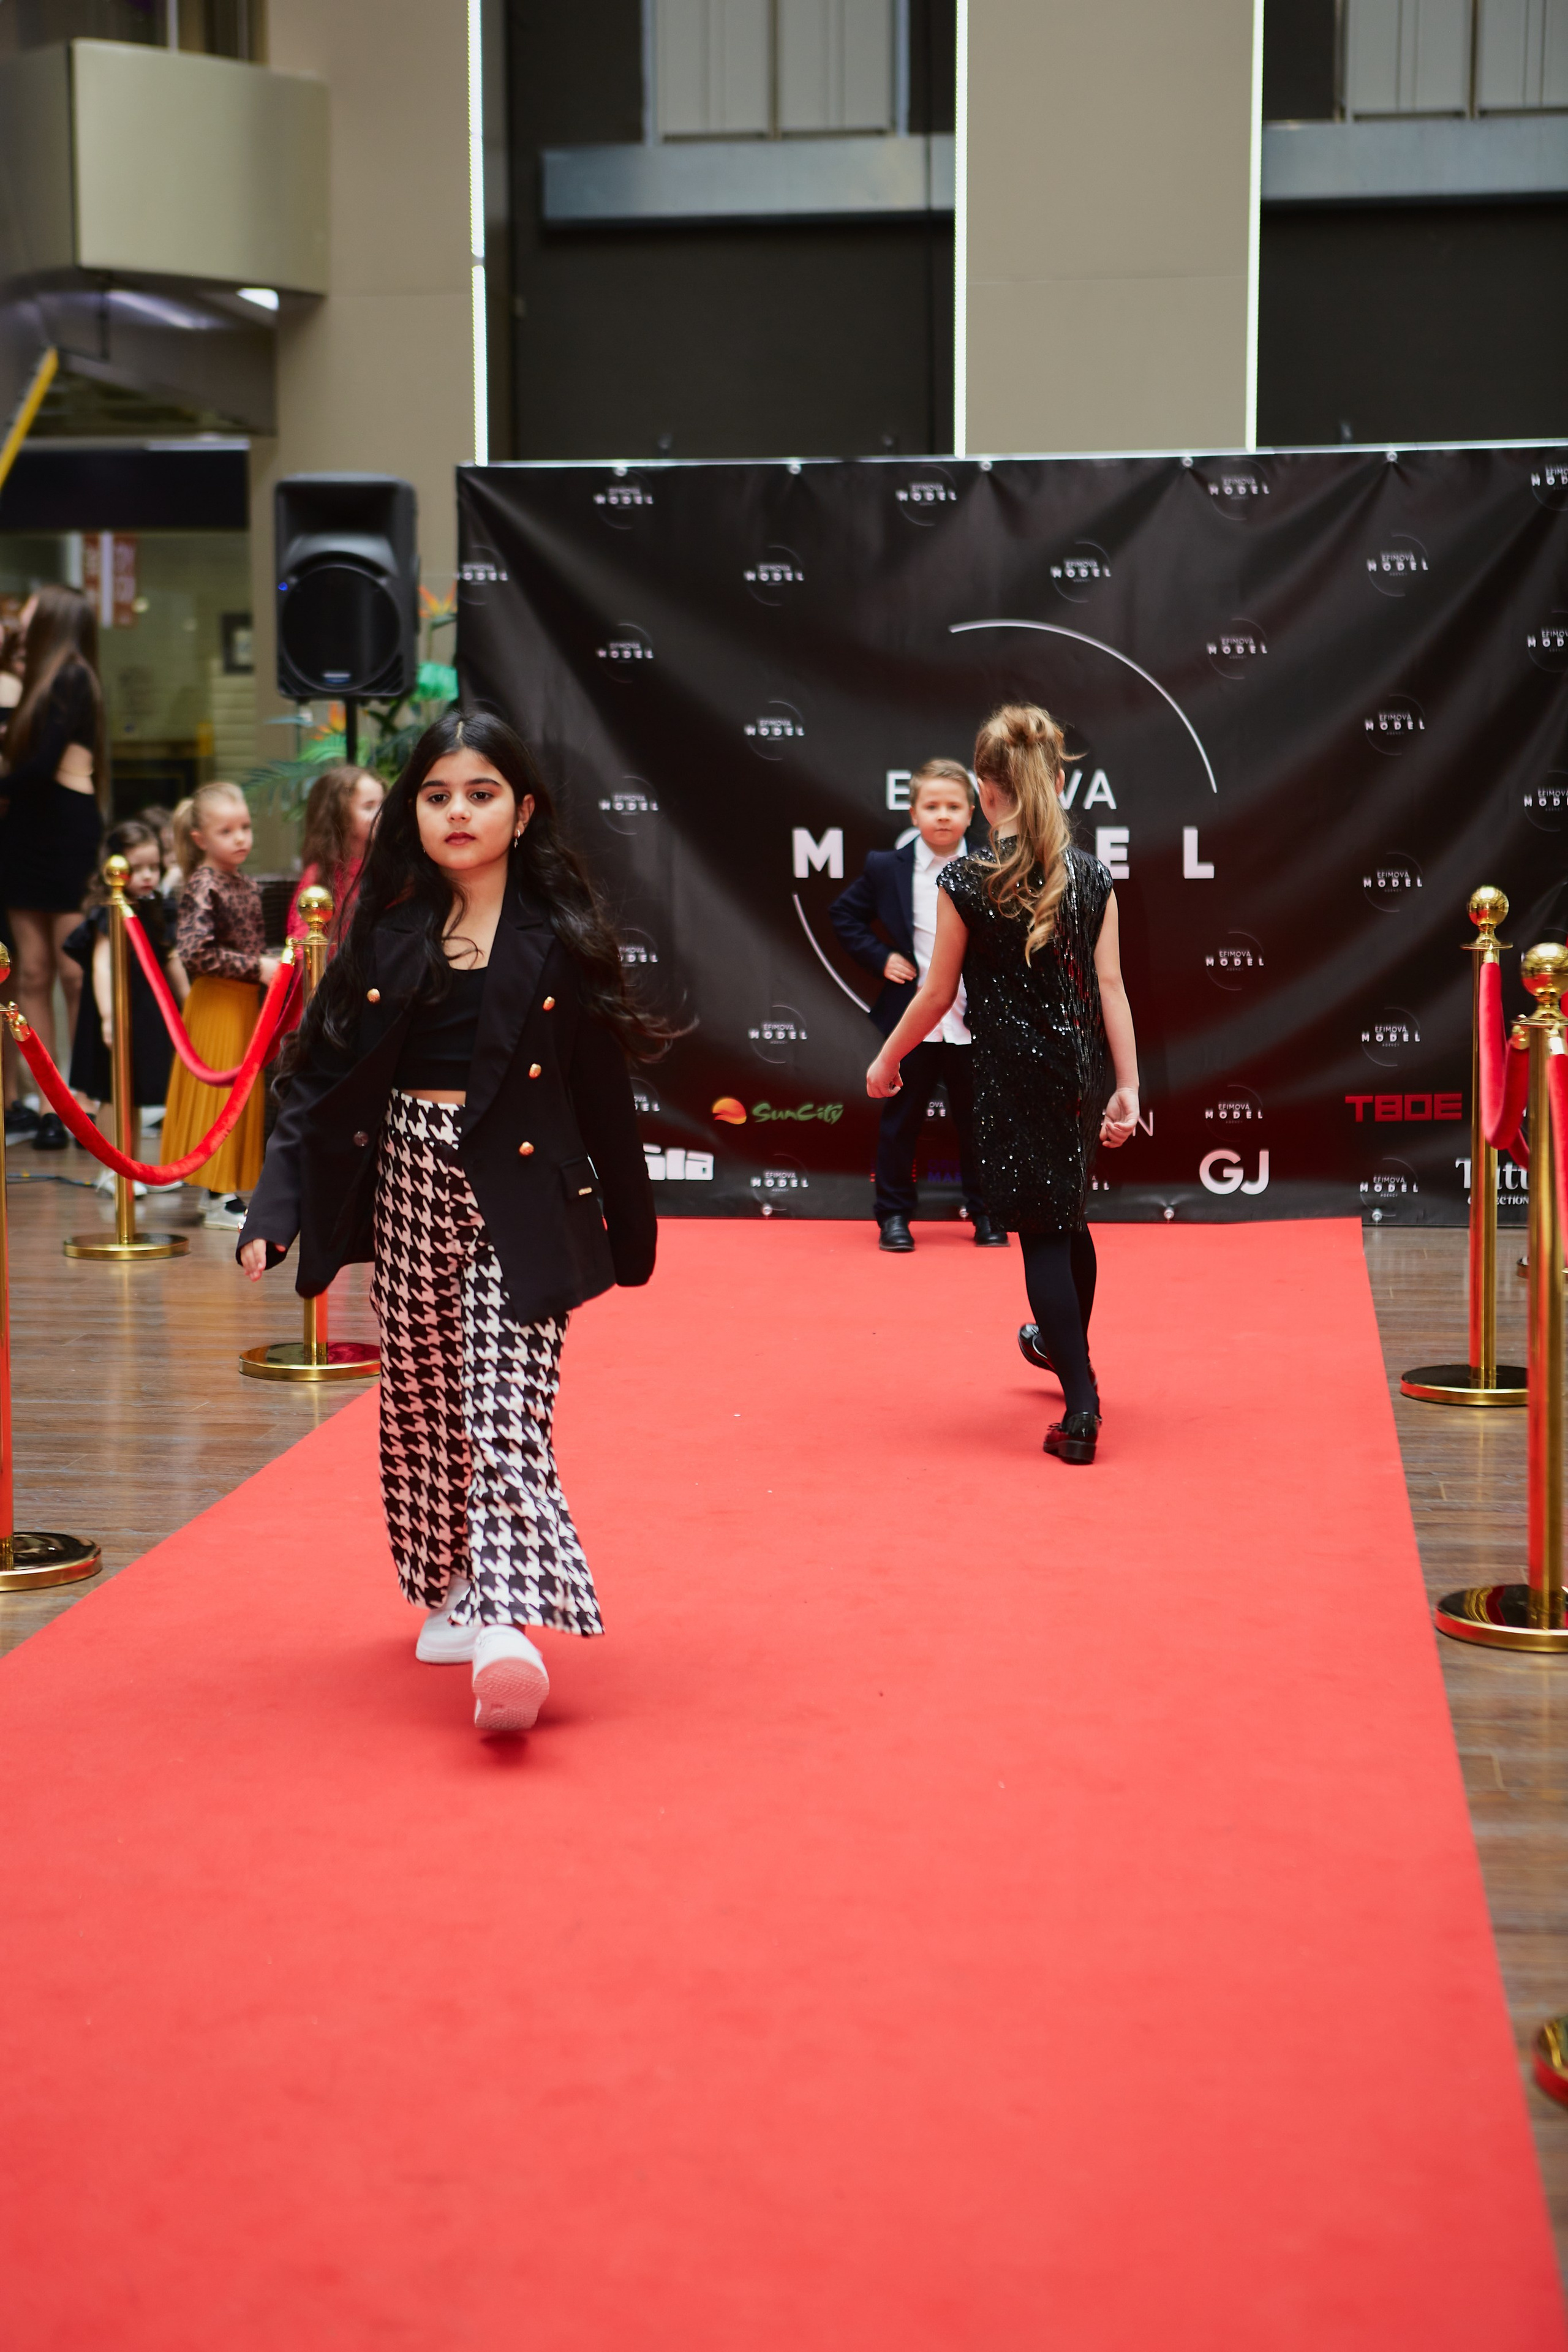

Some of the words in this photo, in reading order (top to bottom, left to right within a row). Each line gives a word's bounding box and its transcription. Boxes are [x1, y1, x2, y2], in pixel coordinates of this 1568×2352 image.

[1531, 475, 1568, 486] MOD
[1208, 484, 1269, 495] MODEL
[896, 491, 957, 502] MODEL
[1366, 560, 1428, 571] MODEL
[744, 570, 804, 581] MODEL
[1050, 567, 1111, 578] MODEL
[1527, 637, 1564, 647] MOD
[1207, 644, 1268, 654] MODEL
[744, 726, 804, 736] MODEL
[1365, 721, 1425, 731] MODEL
[599, 801, 659, 811] MODEL
[1524, 796, 1568, 807] MOD
[793, 826, 1215, 880] MEL
[1363, 878, 1423, 888] MODEL
[1205, 957, 1264, 967] MODEL
[748, 1030, 807, 1040] MODEL
[1362, 1032, 1420, 1042] MODEL
[753, 1102, 844, 1125] SunCity
[1205, 1110, 1263, 1119] MODEL
[1199, 1148, 1270, 1195] GJ
[750, 1177, 809, 1188] MODEL
[1360, 1183, 1419, 1193] MODEL
